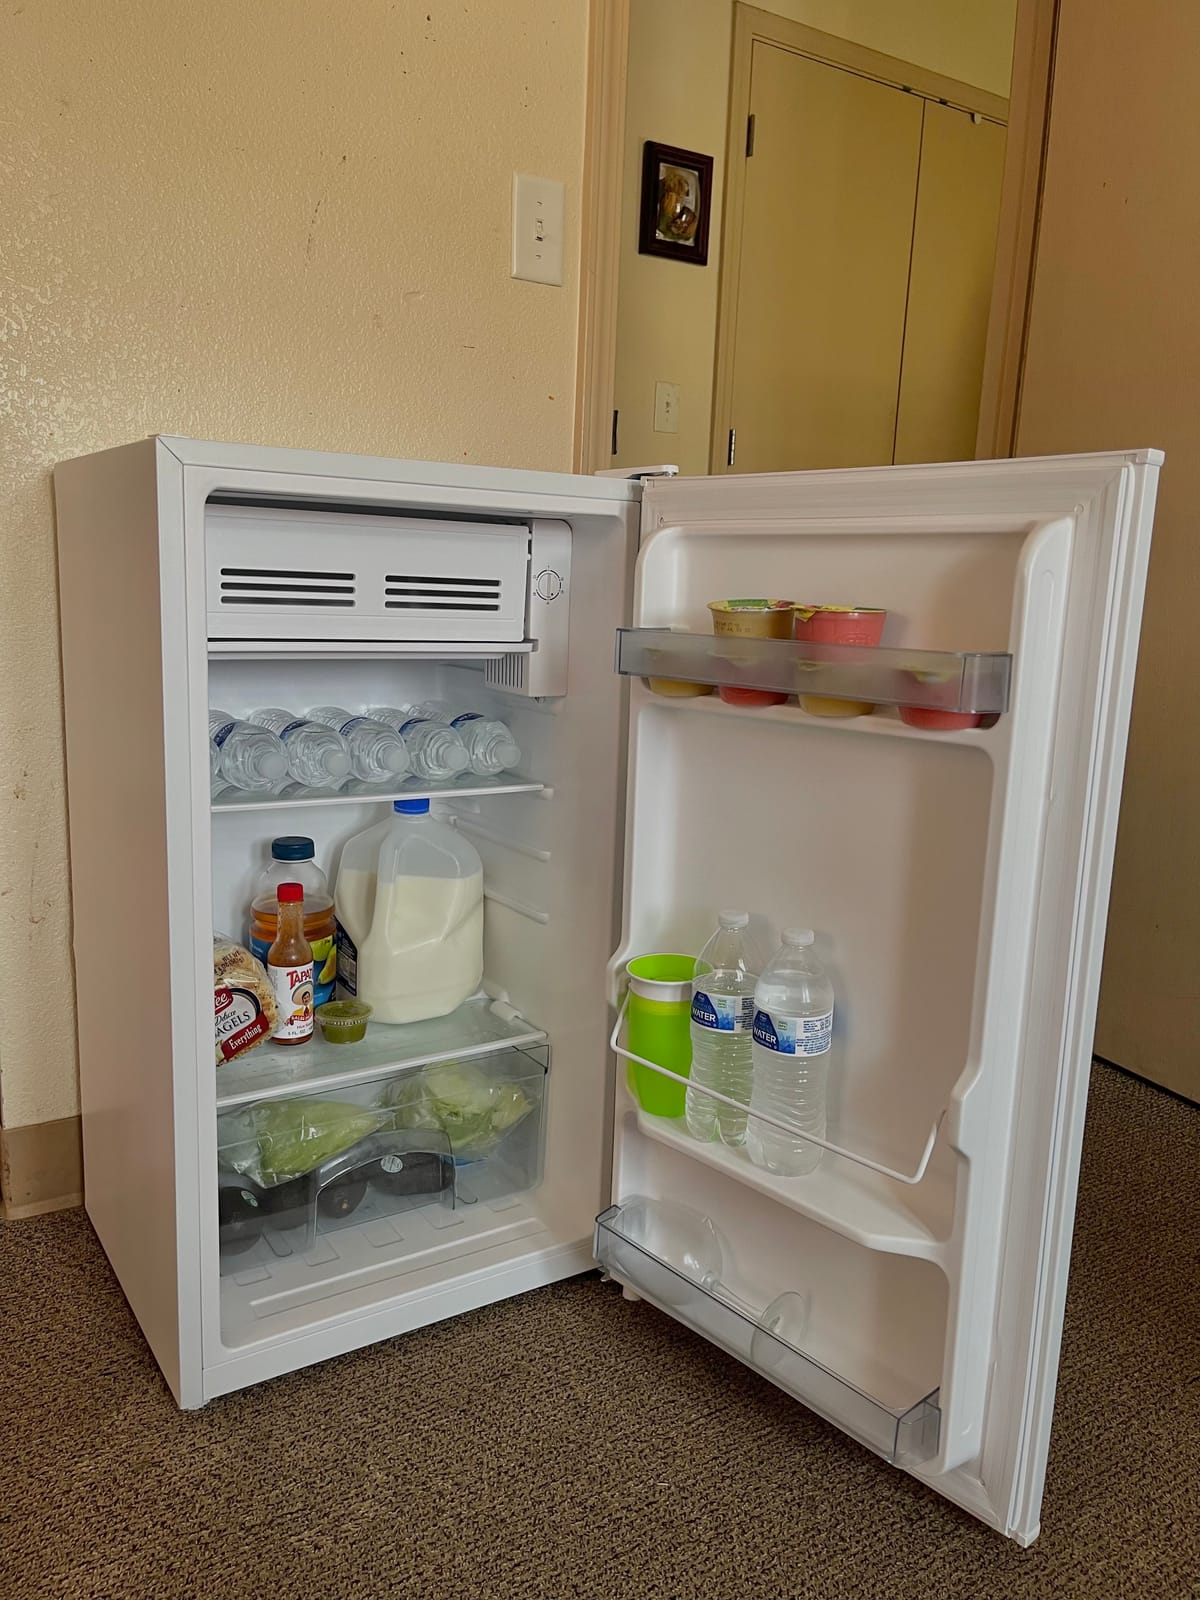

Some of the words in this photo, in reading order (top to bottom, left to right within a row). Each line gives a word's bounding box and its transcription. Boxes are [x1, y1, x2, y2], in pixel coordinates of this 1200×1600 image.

[214, 1010, 252, 1039] AGELS
[693, 1007, 716, 1022] WATER
[229, 1025, 263, 1050] Everything
[753, 1026, 777, 1044] WATER
